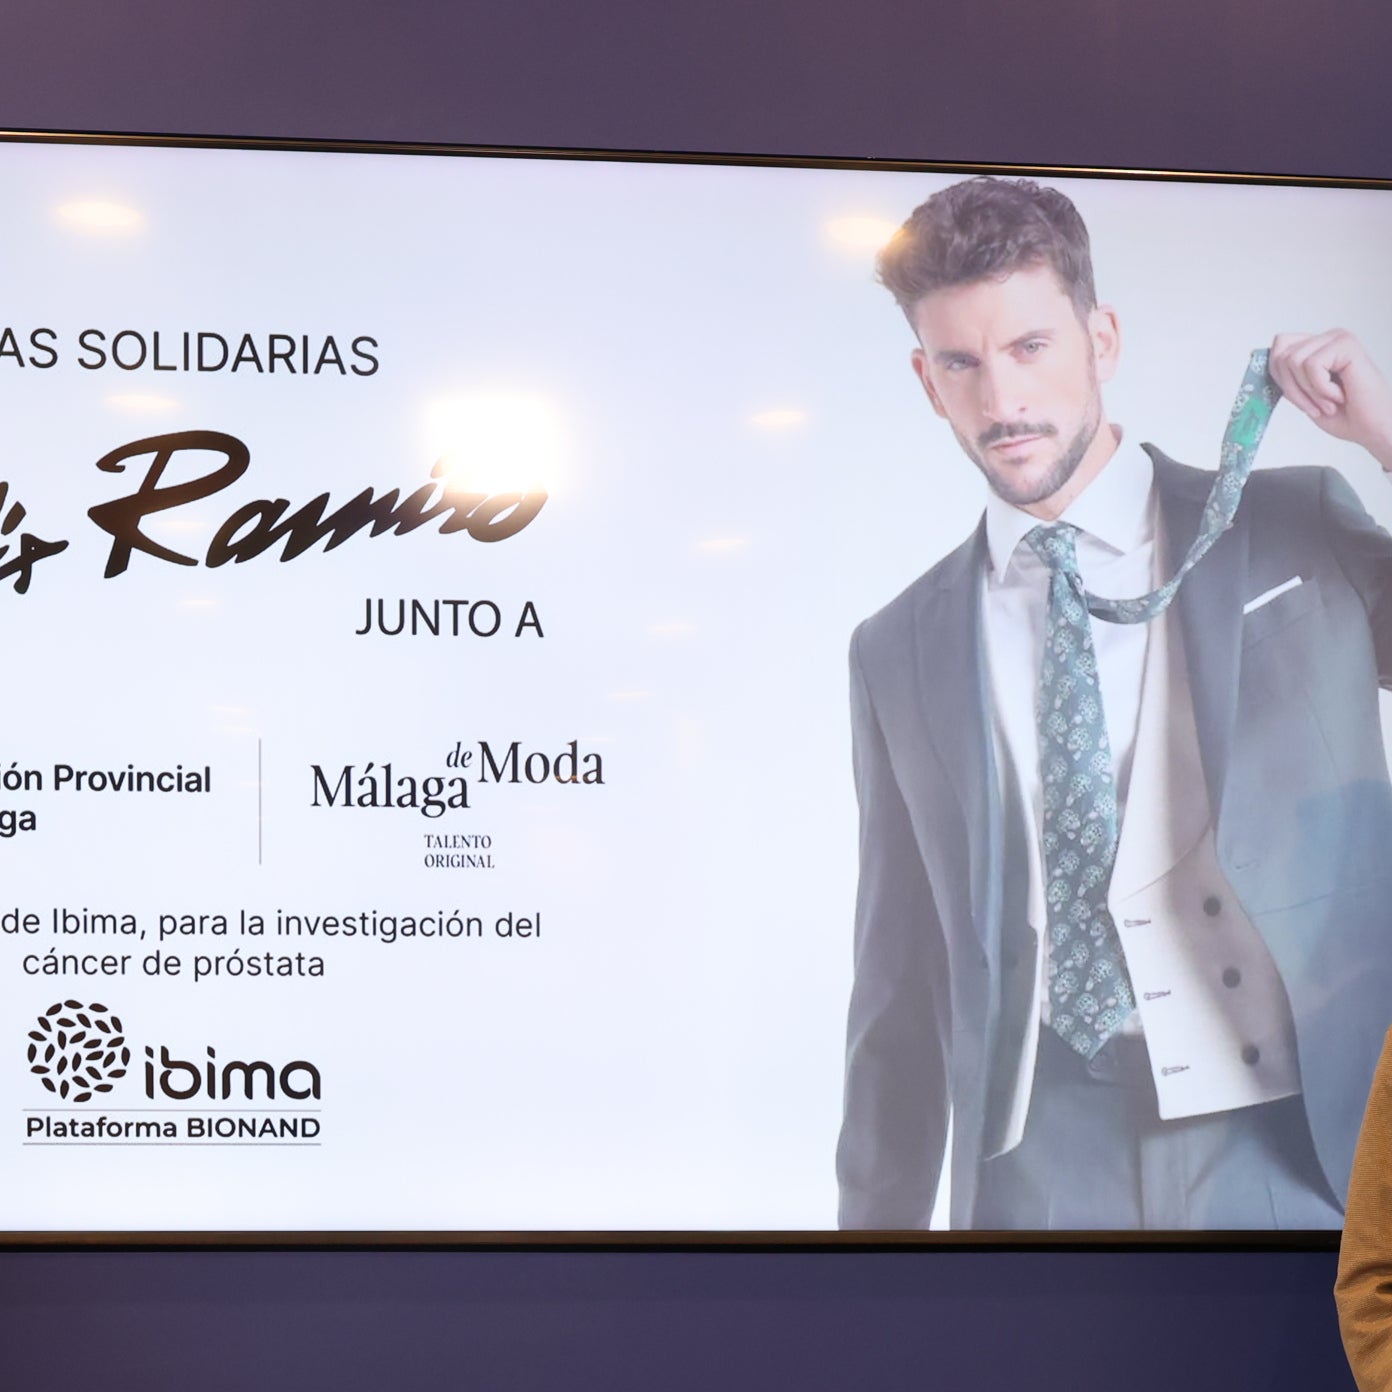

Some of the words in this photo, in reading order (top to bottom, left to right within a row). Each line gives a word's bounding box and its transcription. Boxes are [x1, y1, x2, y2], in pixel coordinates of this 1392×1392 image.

[77, 328, 379, 377] SOLIDARIAS
[355, 598, 501, 638] JUNTO
[514, 601, 544, 638] A
[54, 764, 211, 793] Provincial
[310, 761, 471, 819] Málaga
[446, 741, 473, 768] de
[477, 739, 606, 785] Moda
[424, 834, 492, 850] TALENTO
[424, 854, 495, 869] ORIGINAL
[1, 907, 41, 934] de
[53, 908, 146, 940] Ibima,
[159, 914, 227, 942] para
[240, 909, 264, 936] la
[277, 909, 483, 944] investigación
[495, 911, 540, 938] del
[22, 946, 132, 976] cáncer
[142, 949, 181, 976] de
[194, 948, 324, 983] próstata
[144, 1045, 321, 1100] ibima
[26, 1116, 177, 1138] Plataforma
[187, 1117, 321, 1138] BIONAND
